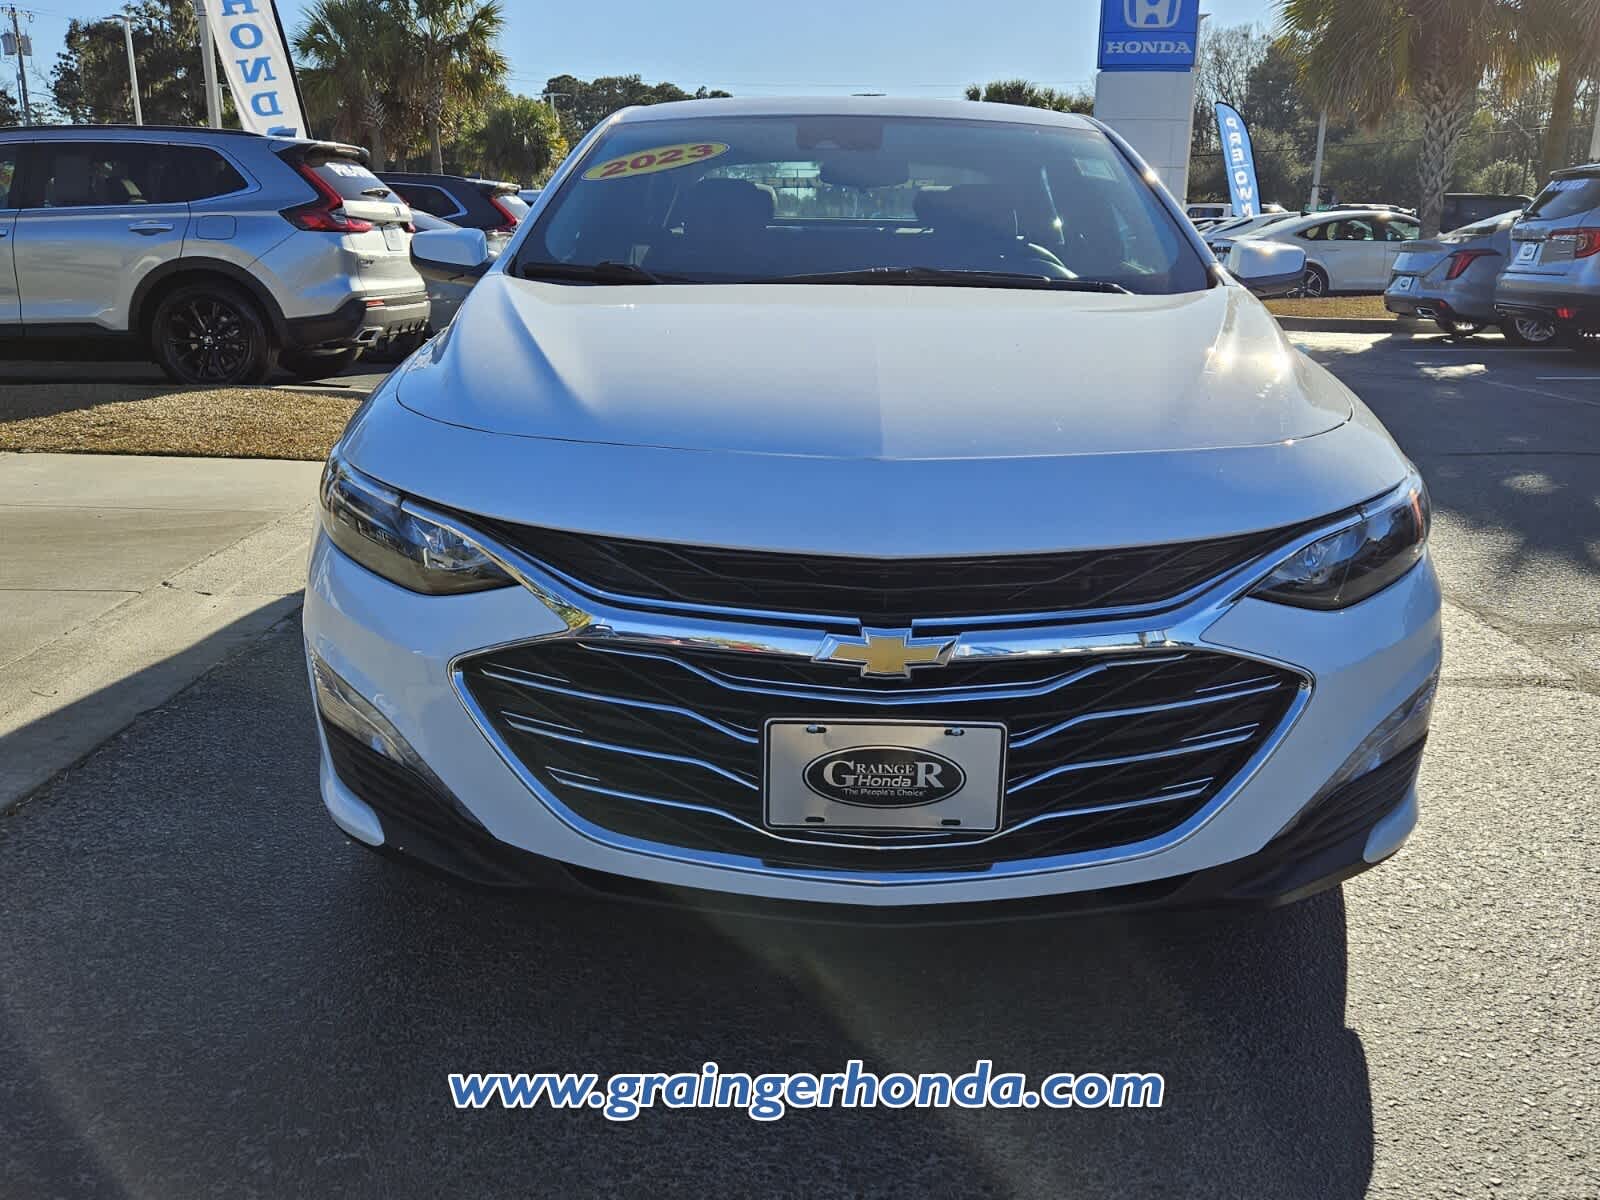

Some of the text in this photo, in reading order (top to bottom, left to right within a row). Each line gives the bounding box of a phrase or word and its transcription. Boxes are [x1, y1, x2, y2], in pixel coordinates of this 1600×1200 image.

[1105, 41, 1192, 54] HONDA
[600, 144, 713, 178] 2023
[823, 760, 945, 788] GRAINGER
[857, 775, 912, 787] Honda
[860, 788, 896, 798] People's
